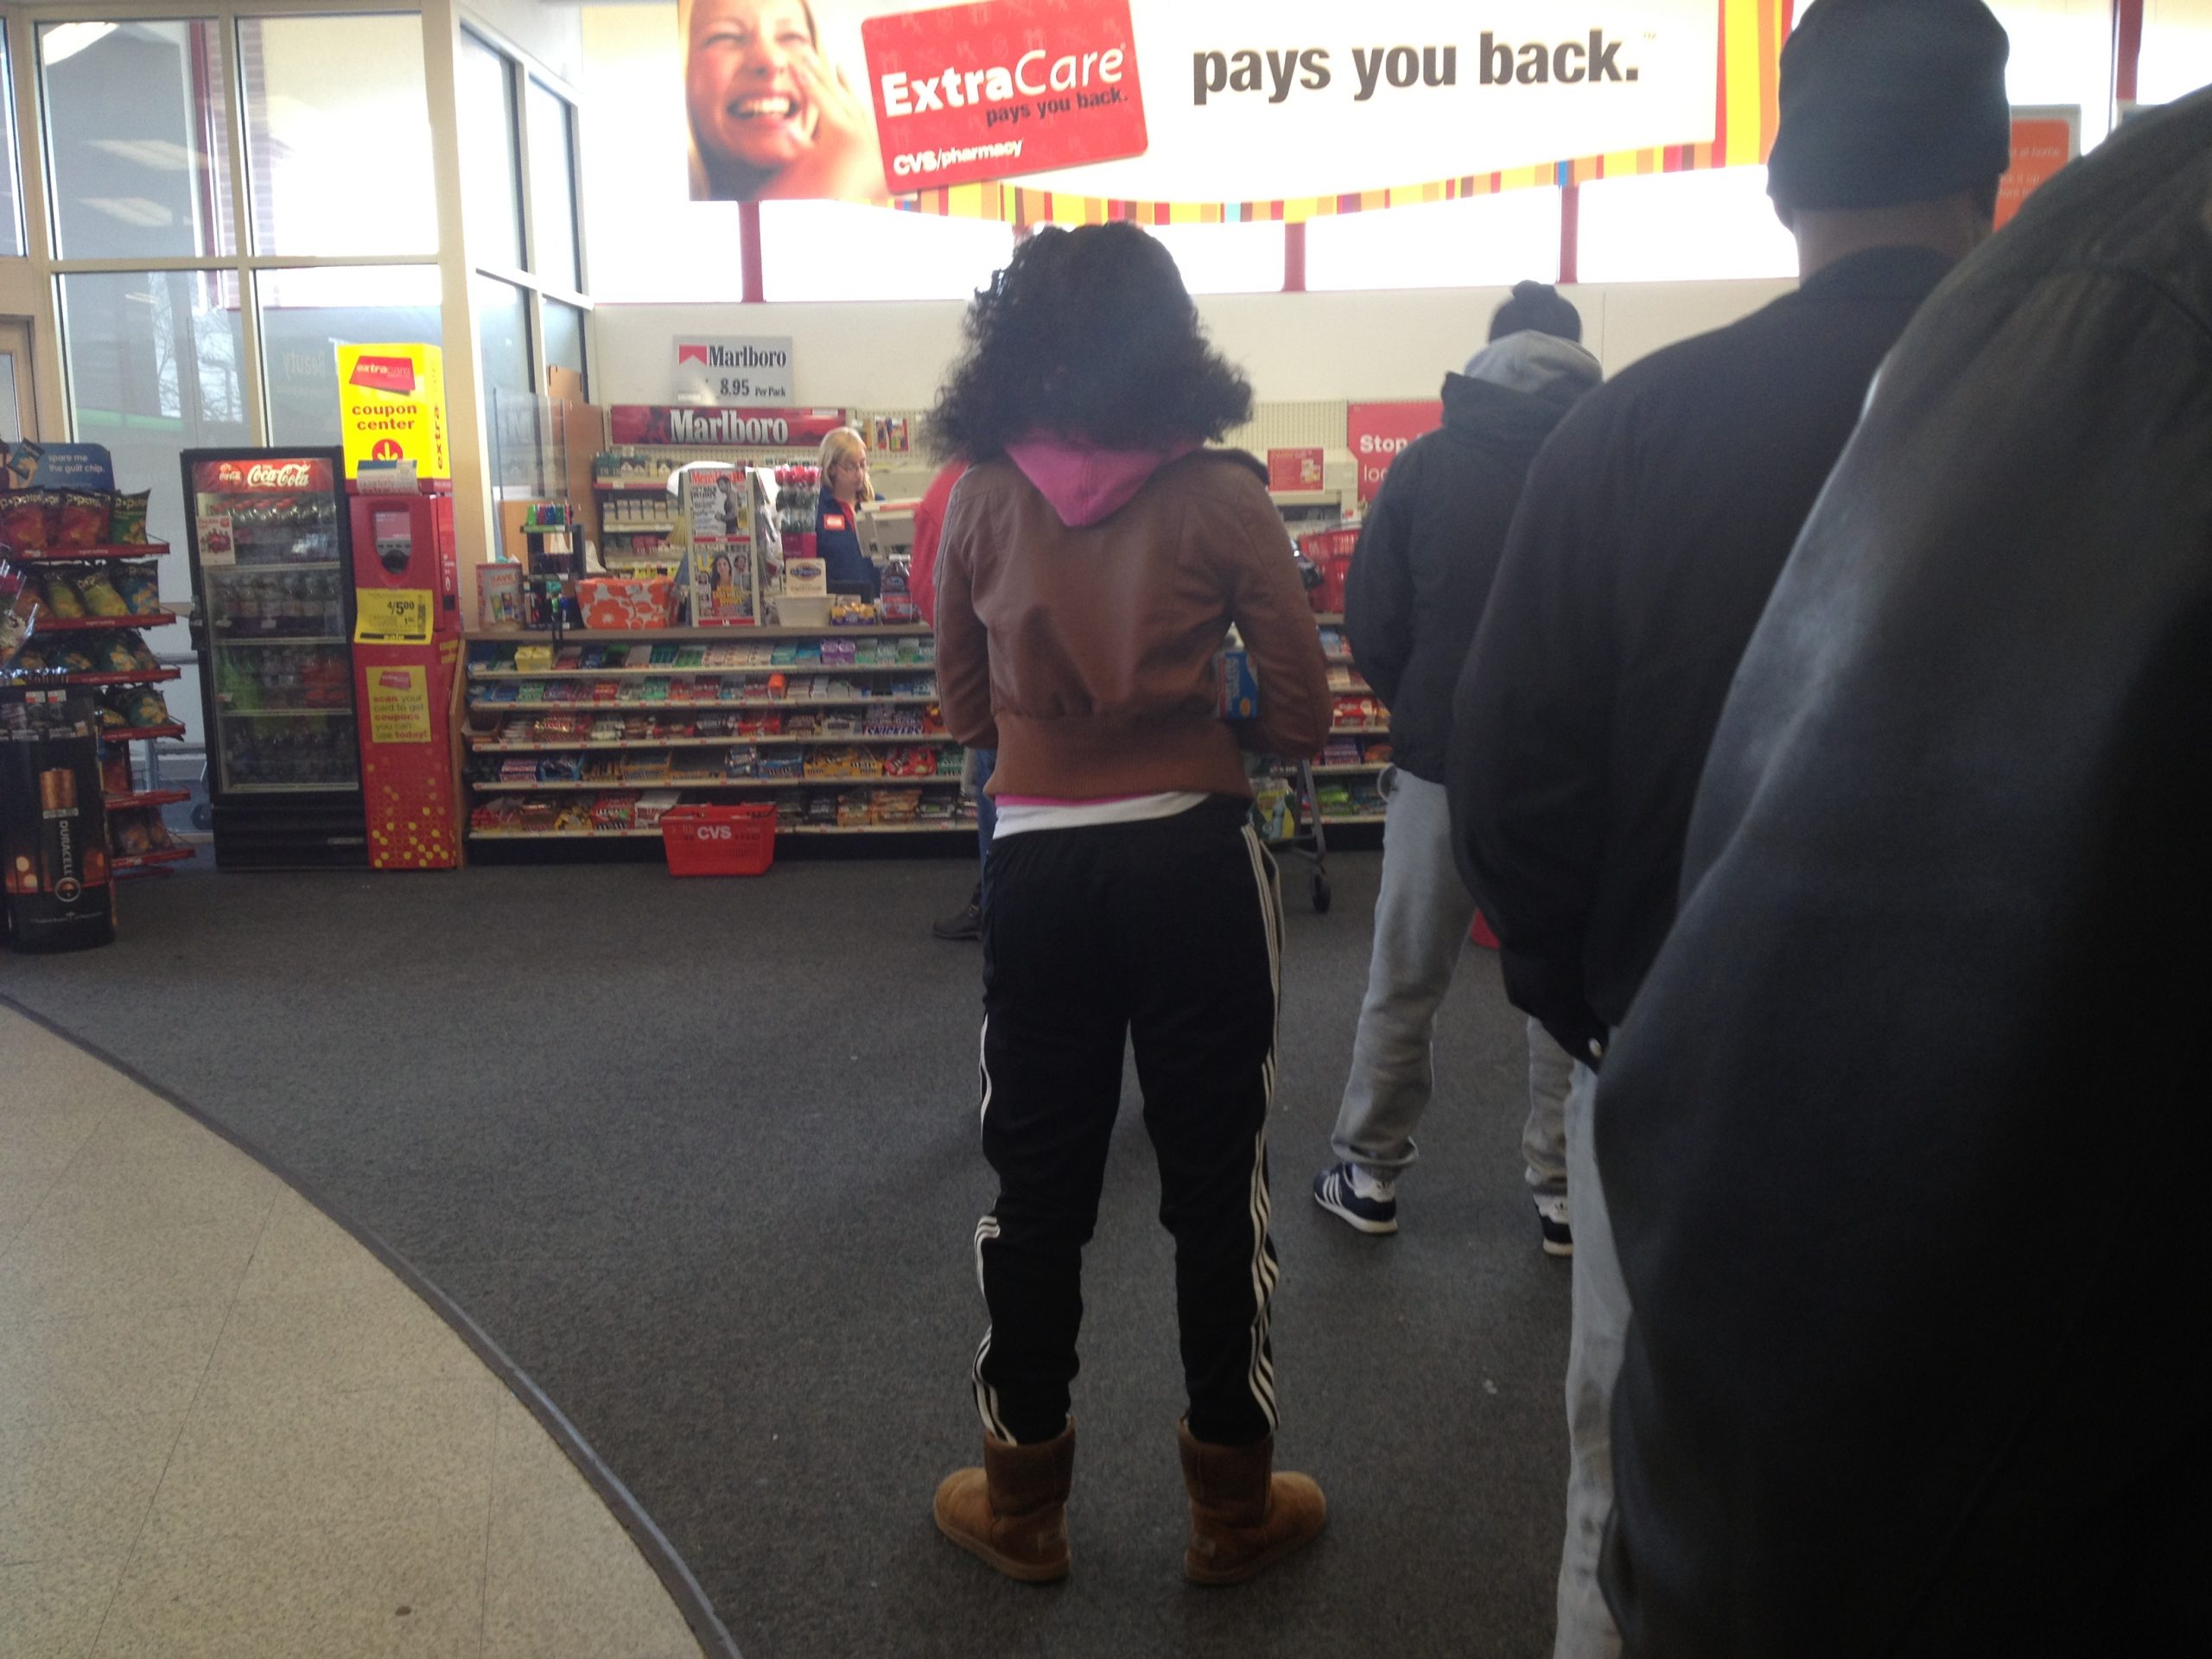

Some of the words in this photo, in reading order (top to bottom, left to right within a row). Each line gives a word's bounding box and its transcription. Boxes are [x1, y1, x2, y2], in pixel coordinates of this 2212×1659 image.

[1193, 48, 1332, 106] pays
[1352, 44, 1457, 102] you
[1479, 28, 1639, 86] back.
[880, 46, 1124, 118] ExtraCare
[985, 102, 1032, 128] pays
[1037, 97, 1071, 121] you
[1076, 86, 1129, 111] back.
[893, 138, 1023, 177] CVS/pharmacy
[709, 345, 787, 368] Marlboro
[720, 378, 750, 397] 8.95
[754, 386, 768, 397] Per
[768, 386, 786, 397] Pack
[352, 404, 417, 417] coupon
[357, 418, 415, 430] center
[670, 409, 789, 445] Marlboro
[434, 404, 443, 470] extra
[1359, 434, 1408, 454] Stop
[48, 454, 72, 463] spare
[73, 454, 88, 462] me
[49, 464, 63, 473] the
[65, 463, 83, 474] guilt
[247, 461, 311, 487] Coca-Cola
[373, 703, 394, 712] card
[397, 703, 407, 712] to
[409, 703, 424, 713] get
[402, 696, 422, 704] your
[375, 714, 420, 722] coupons
[375, 723, 393, 732] you
[395, 730, 428, 740] today!
[866, 726, 923, 735] SNICKERS
[696, 824, 733, 841] CVS
[60, 820, 73, 876] DURACELL
